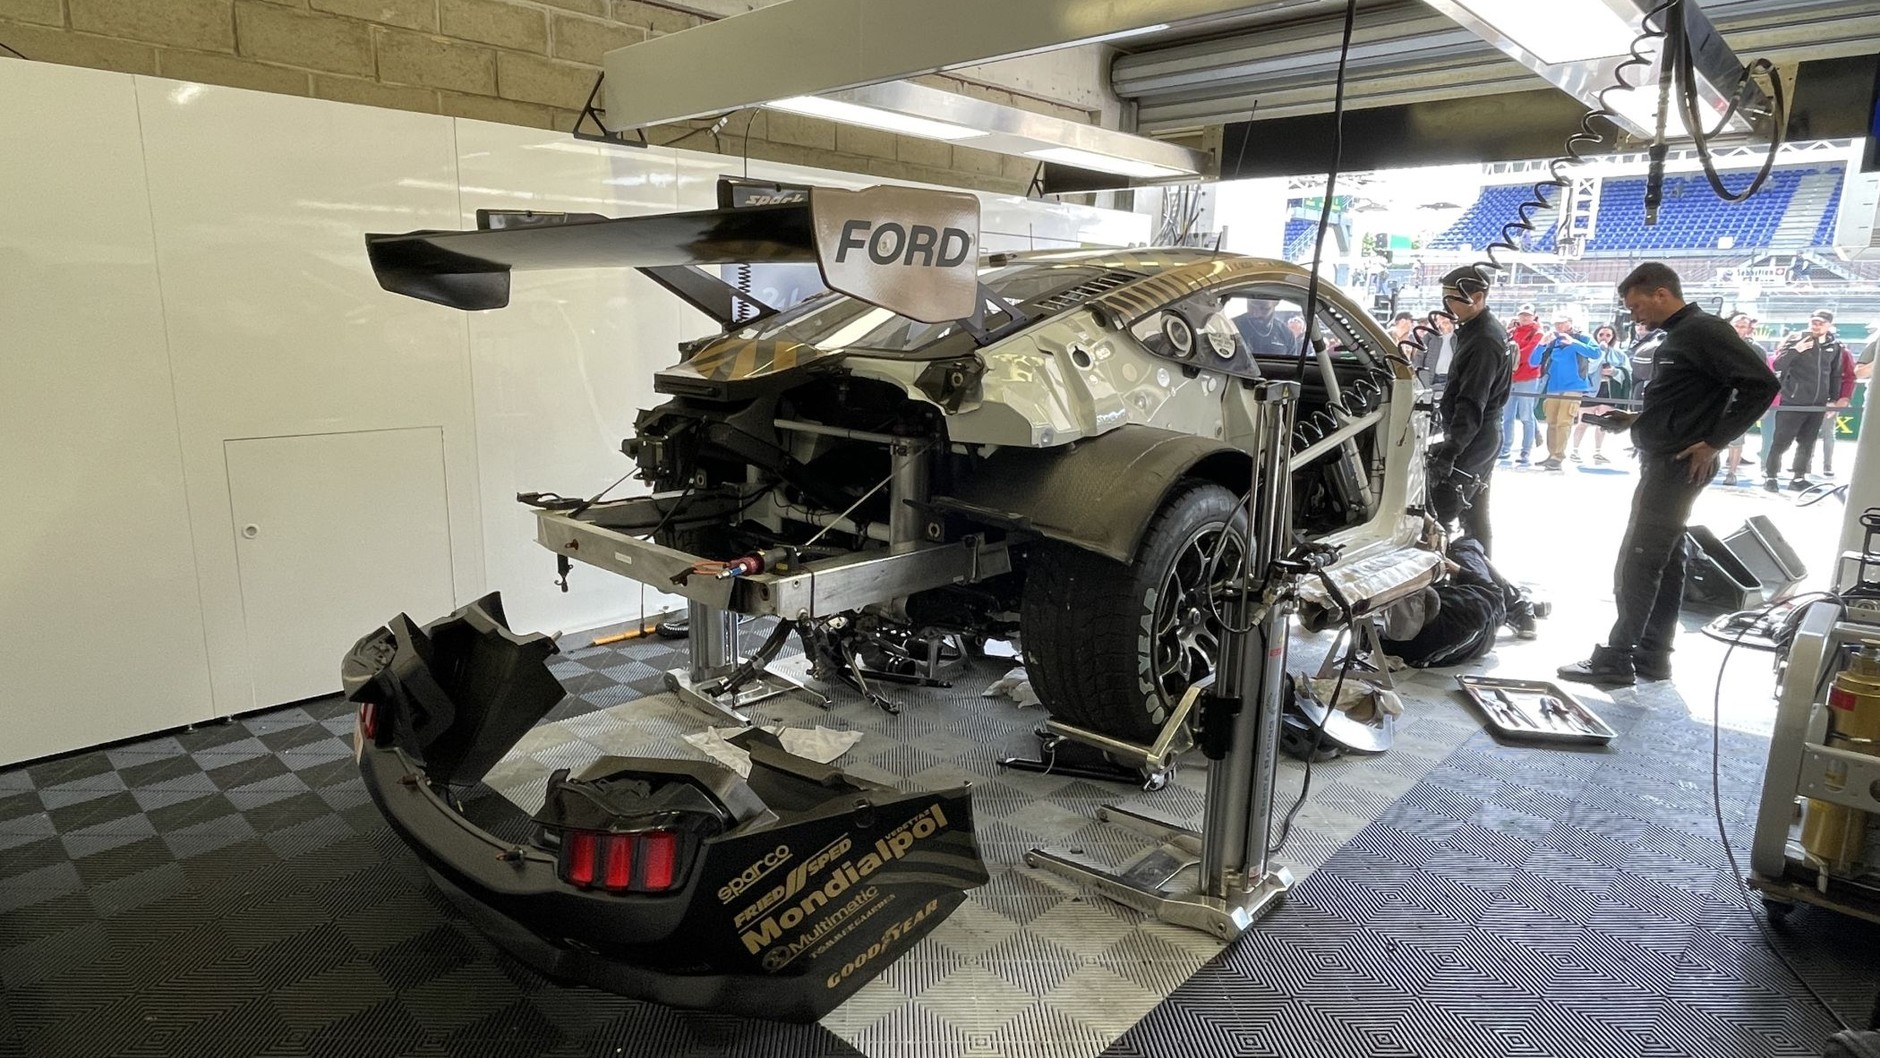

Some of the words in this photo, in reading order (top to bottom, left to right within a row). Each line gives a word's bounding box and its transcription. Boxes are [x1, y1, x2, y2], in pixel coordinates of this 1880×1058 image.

[836, 220, 970, 268] FORD
[717, 844, 790, 901] sparco
[740, 803, 949, 955] Mondialpol
[789, 886, 879, 954] Multimatic
[826, 898, 939, 989] GOODYEAR
